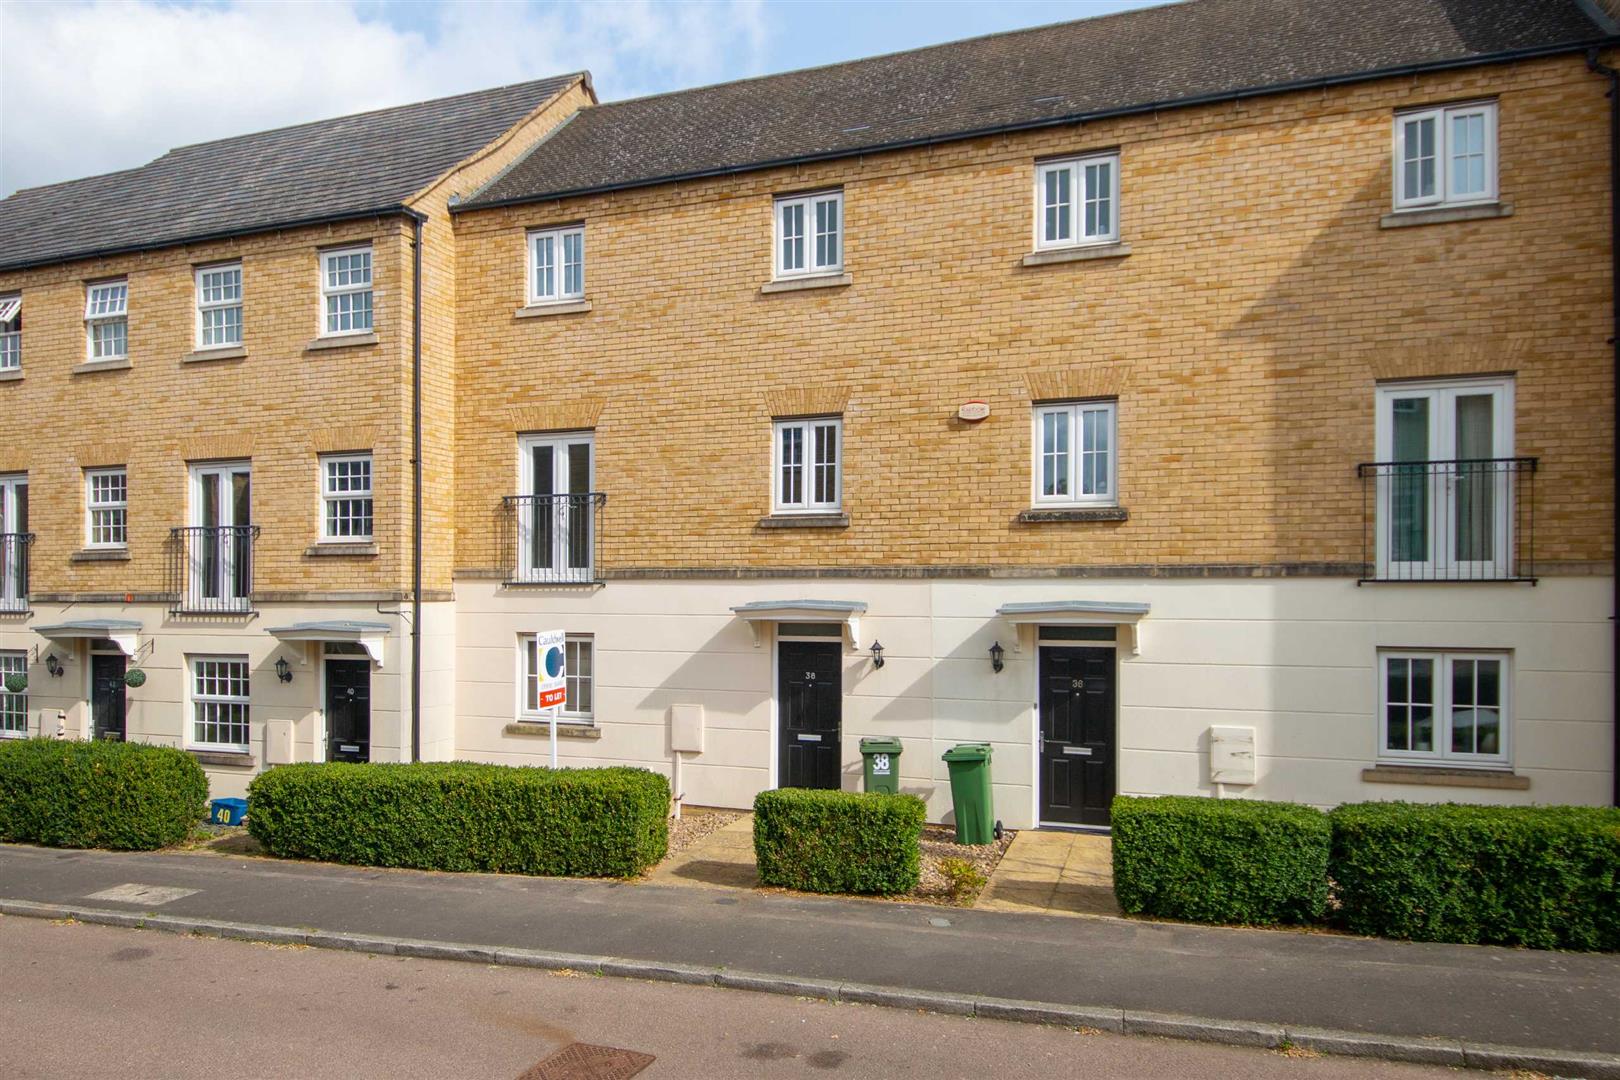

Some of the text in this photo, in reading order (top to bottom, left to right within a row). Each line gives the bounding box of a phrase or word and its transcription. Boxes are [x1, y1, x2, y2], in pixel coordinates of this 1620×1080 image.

[805, 671, 816, 679] 38
[545, 691, 563, 702] TO LET
[872, 753, 890, 770] 38
[217, 808, 230, 823] 40
